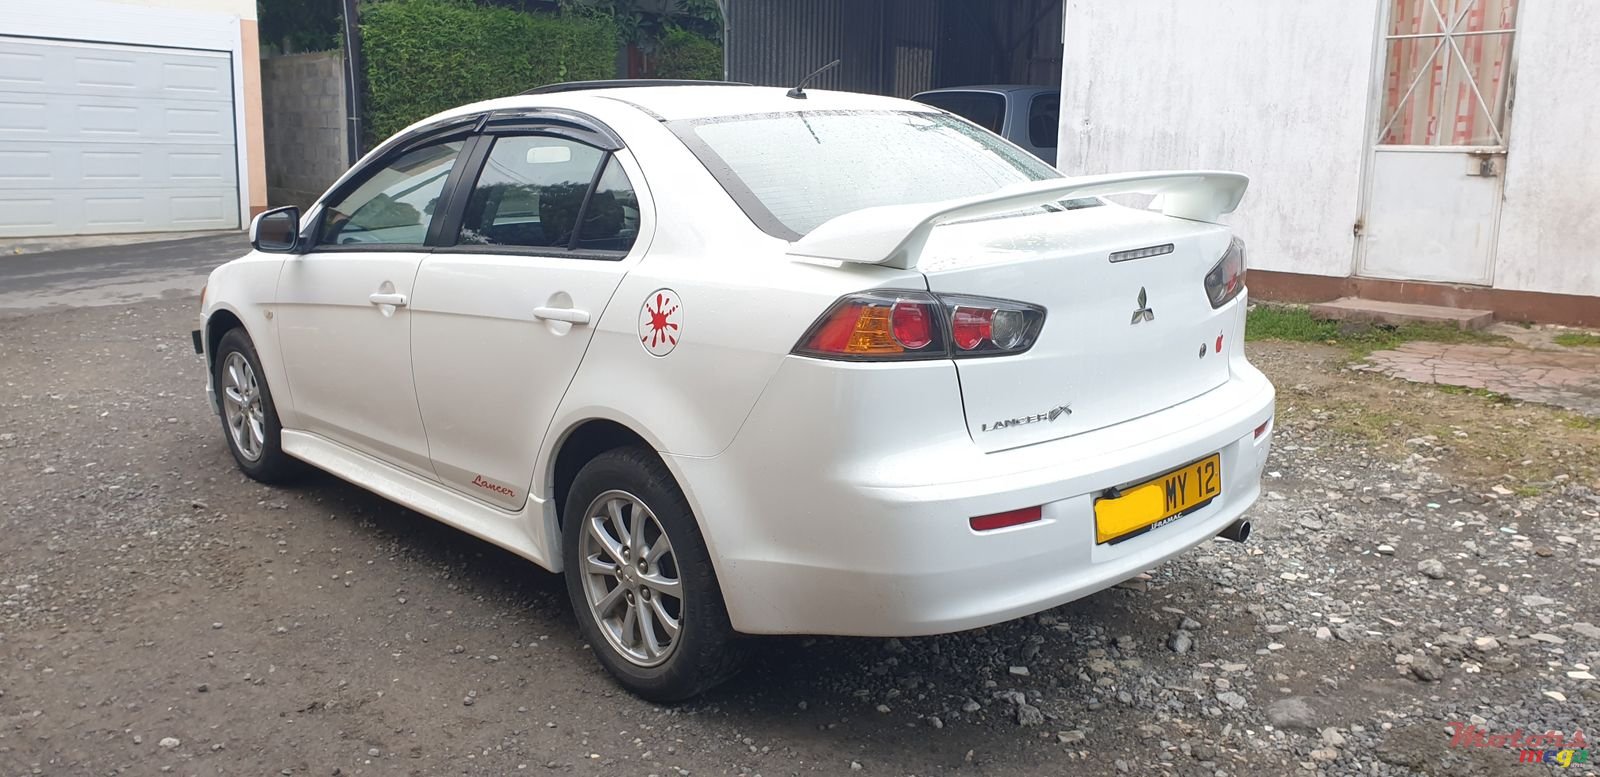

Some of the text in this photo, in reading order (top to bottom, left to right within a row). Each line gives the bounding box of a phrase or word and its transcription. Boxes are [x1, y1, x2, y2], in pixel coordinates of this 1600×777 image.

[982, 413, 1047, 432] LANCER
[472, 475, 515, 497] Lancer
[1165, 461, 1215, 513] MY 12
